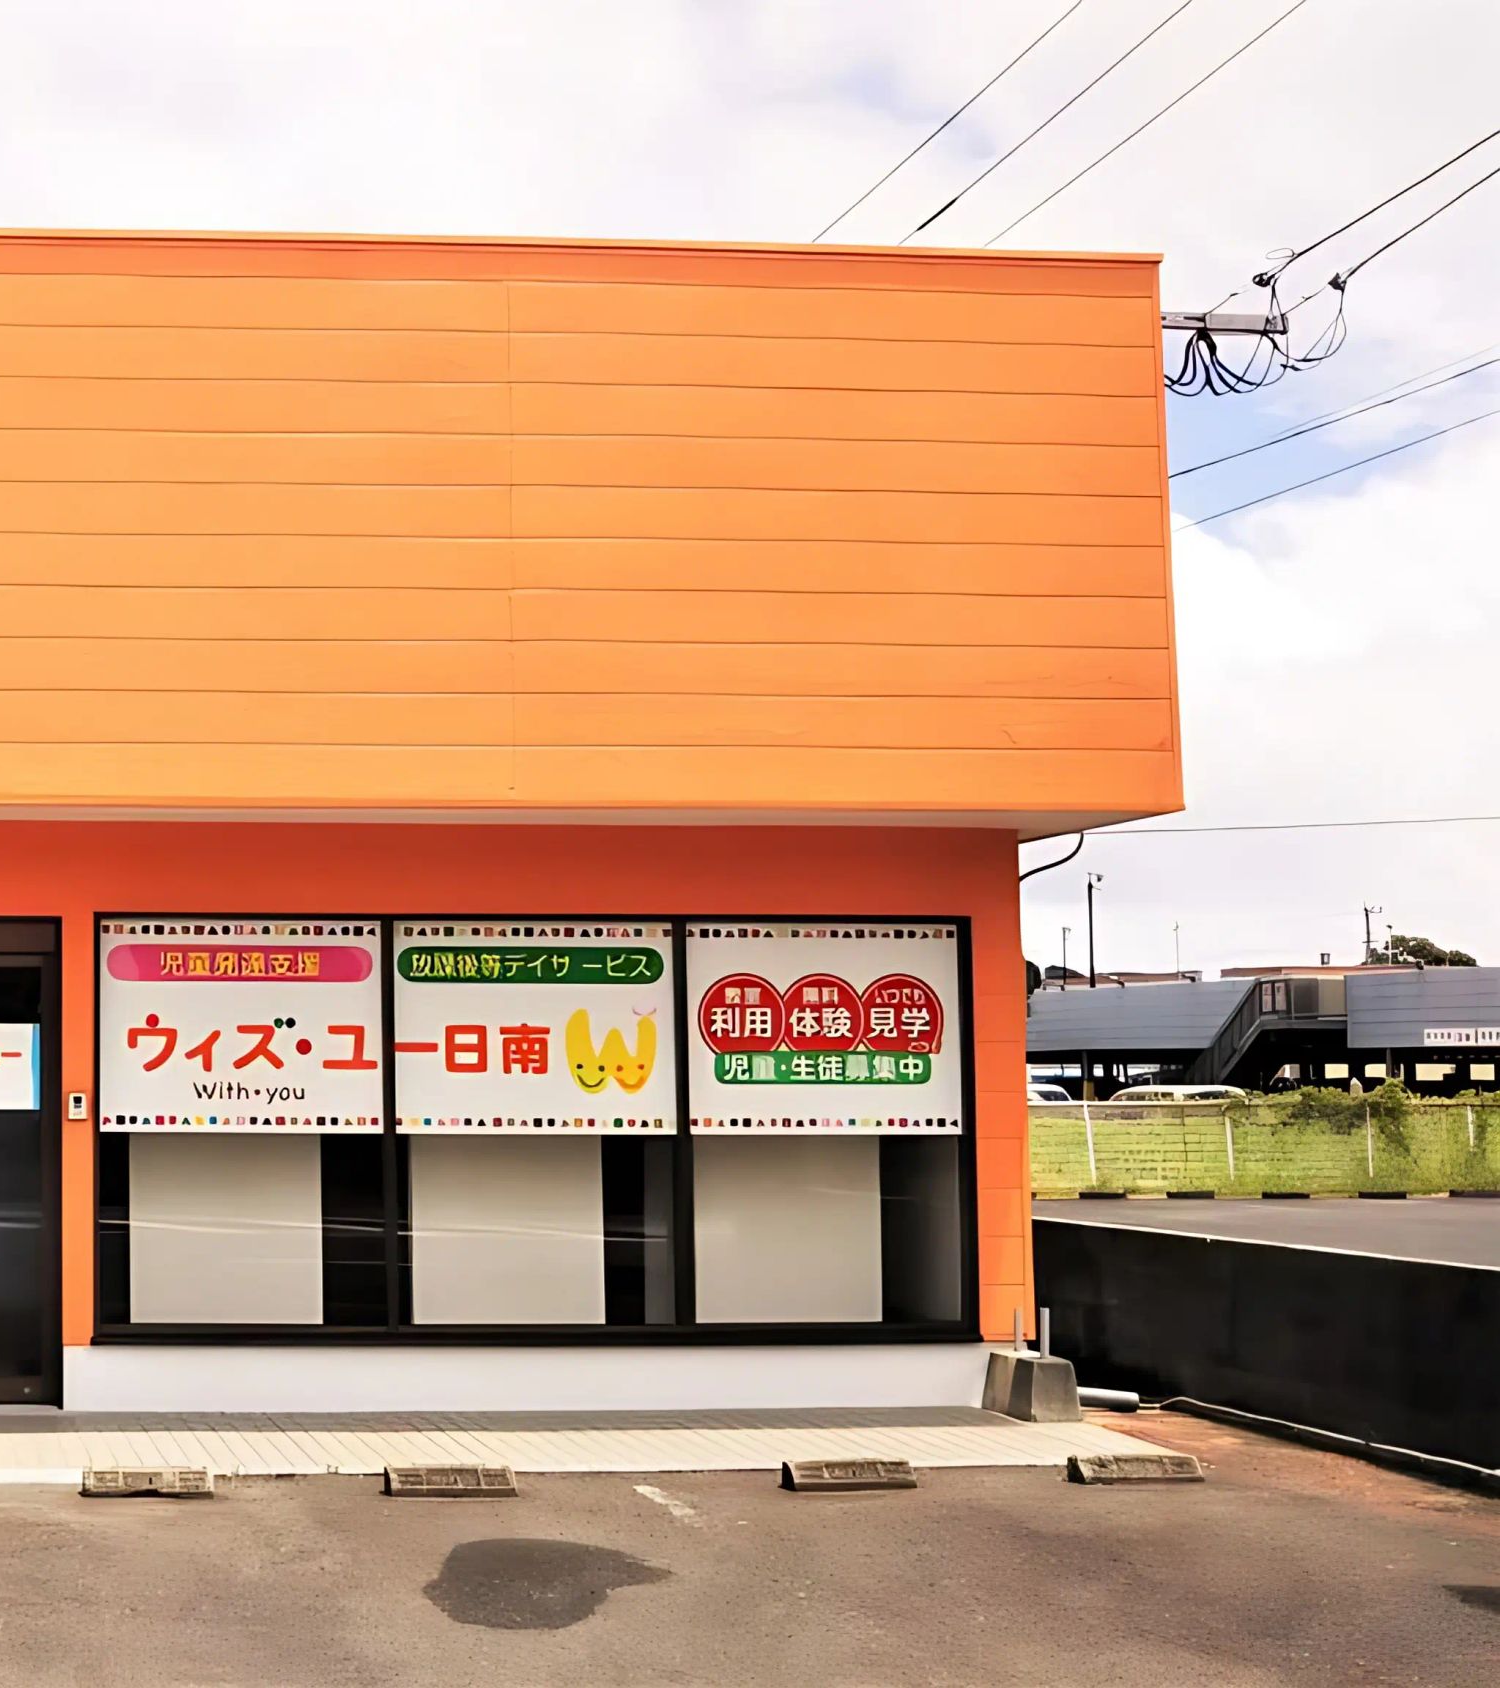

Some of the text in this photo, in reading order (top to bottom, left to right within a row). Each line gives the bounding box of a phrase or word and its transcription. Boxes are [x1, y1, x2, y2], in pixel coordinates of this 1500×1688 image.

[710, 1007, 930, 1038] 利用 体験 見学
